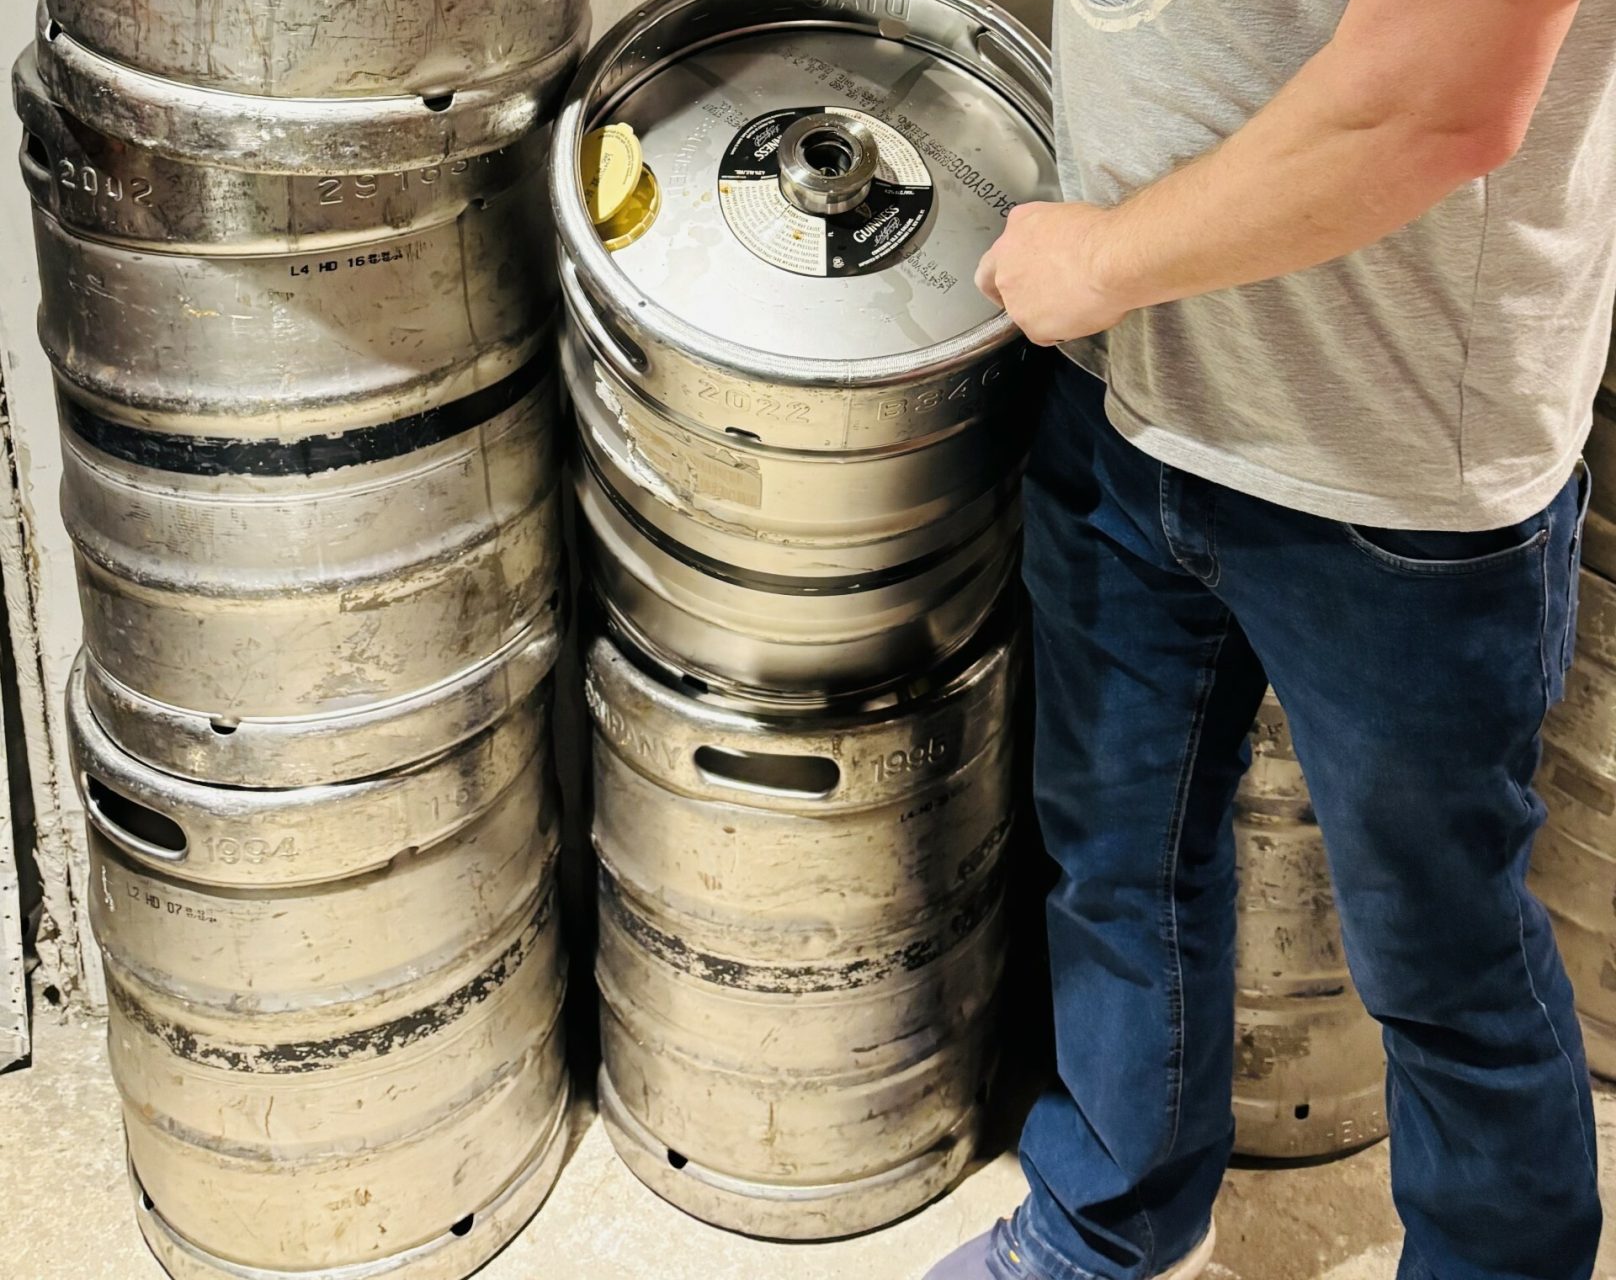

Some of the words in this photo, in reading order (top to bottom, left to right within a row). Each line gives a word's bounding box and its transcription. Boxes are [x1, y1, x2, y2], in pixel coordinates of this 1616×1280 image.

[853, 206, 900, 243] GUINNESS
[319, 261, 338, 272] HD
[698, 378, 811, 424] 2022
[202, 836, 299, 865] 1994
[145, 893, 161, 910] HD
[167, 900, 183, 916] 07
